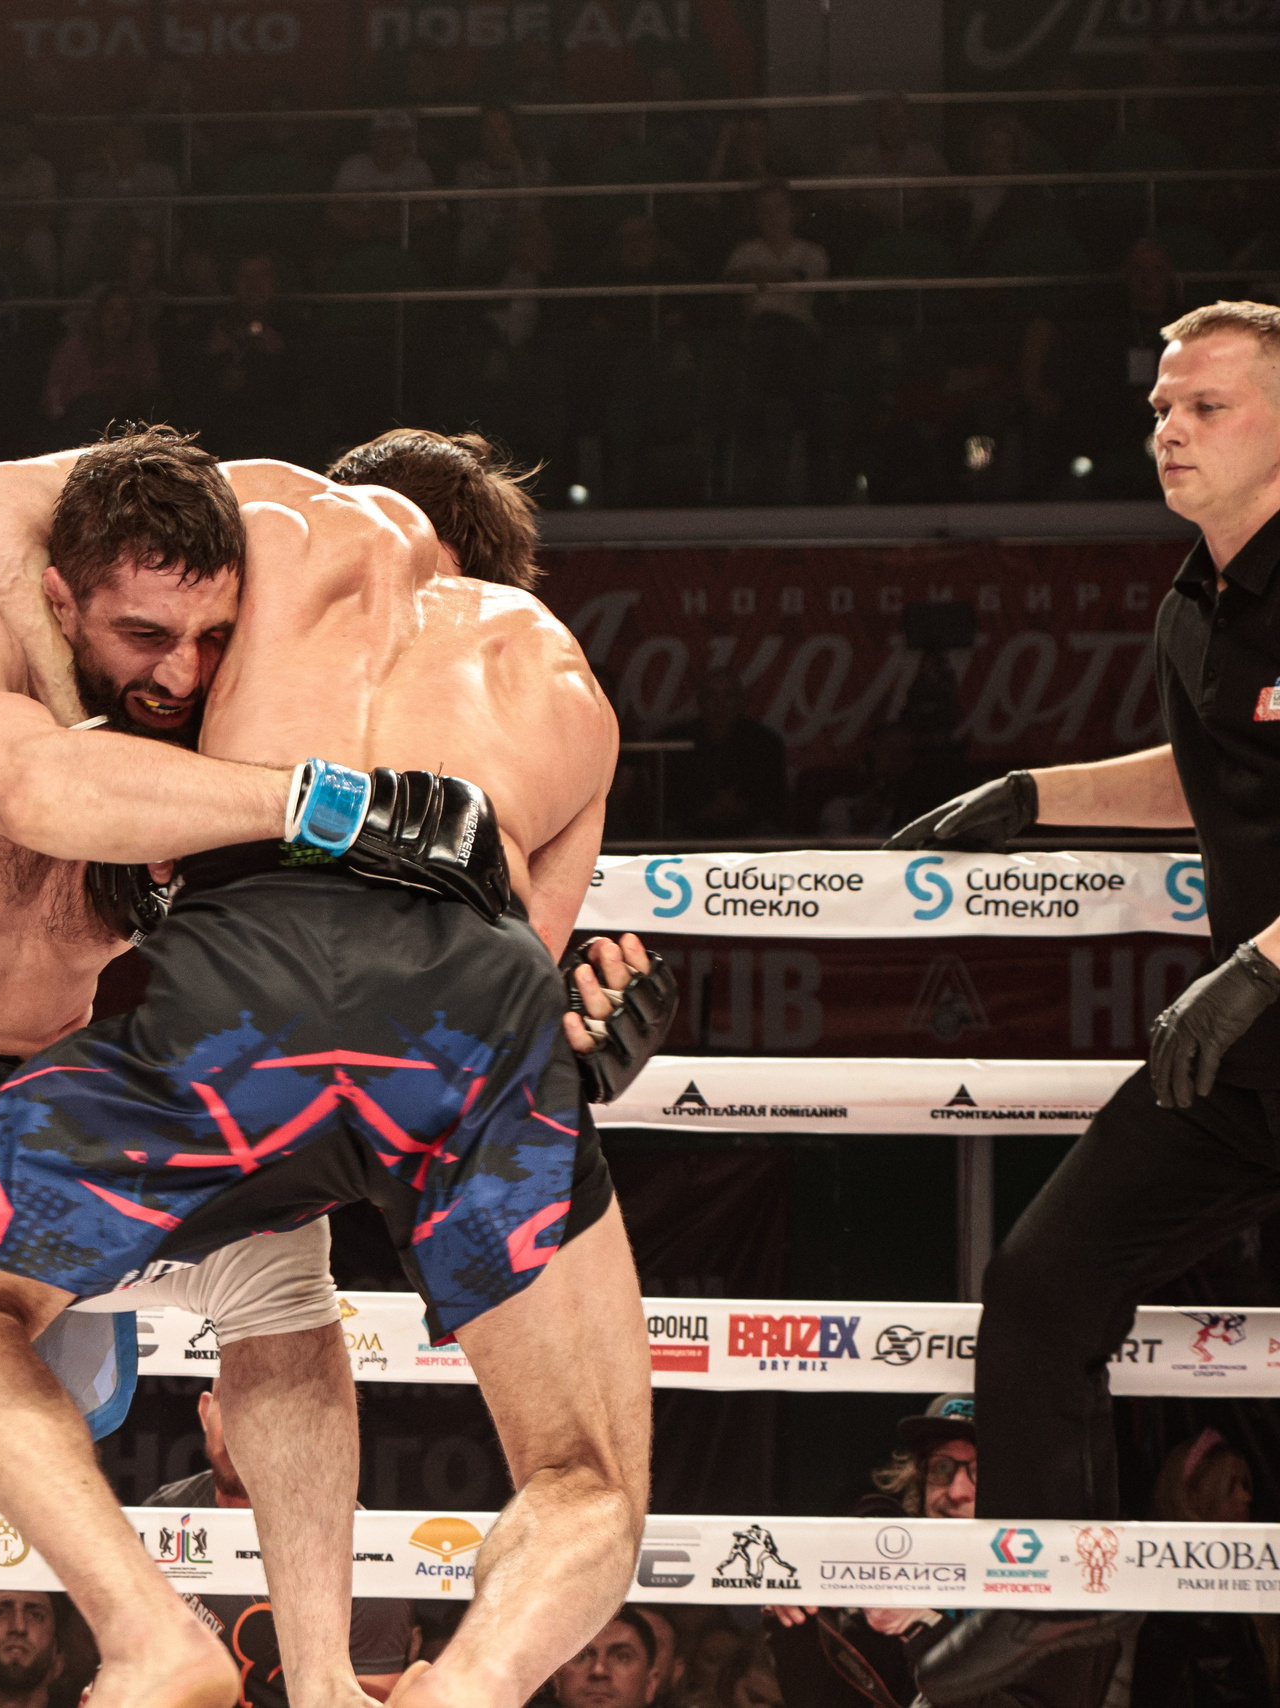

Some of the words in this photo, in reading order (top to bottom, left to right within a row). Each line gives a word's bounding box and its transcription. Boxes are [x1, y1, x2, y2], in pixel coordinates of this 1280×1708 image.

[706, 867, 864, 896] Сибирское
[967, 866, 1125, 895] Сибирское
[705, 893, 819, 918] Стекло
[966, 894, 1079, 918] Стекло
[770, 1106, 848, 1118] КОМПАНИЯ
[930, 1109, 1035, 1120] СТРОИТЕЛЬНАЯ
[647, 1315, 709, 1341] ФОНД
[728, 1313, 861, 1359] BROZEX
[759, 1360, 789, 1371] DRY
[798, 1360, 828, 1372] MIX
[712, 1577, 761, 1589] BOXING
[766, 1579, 802, 1589] HALL
